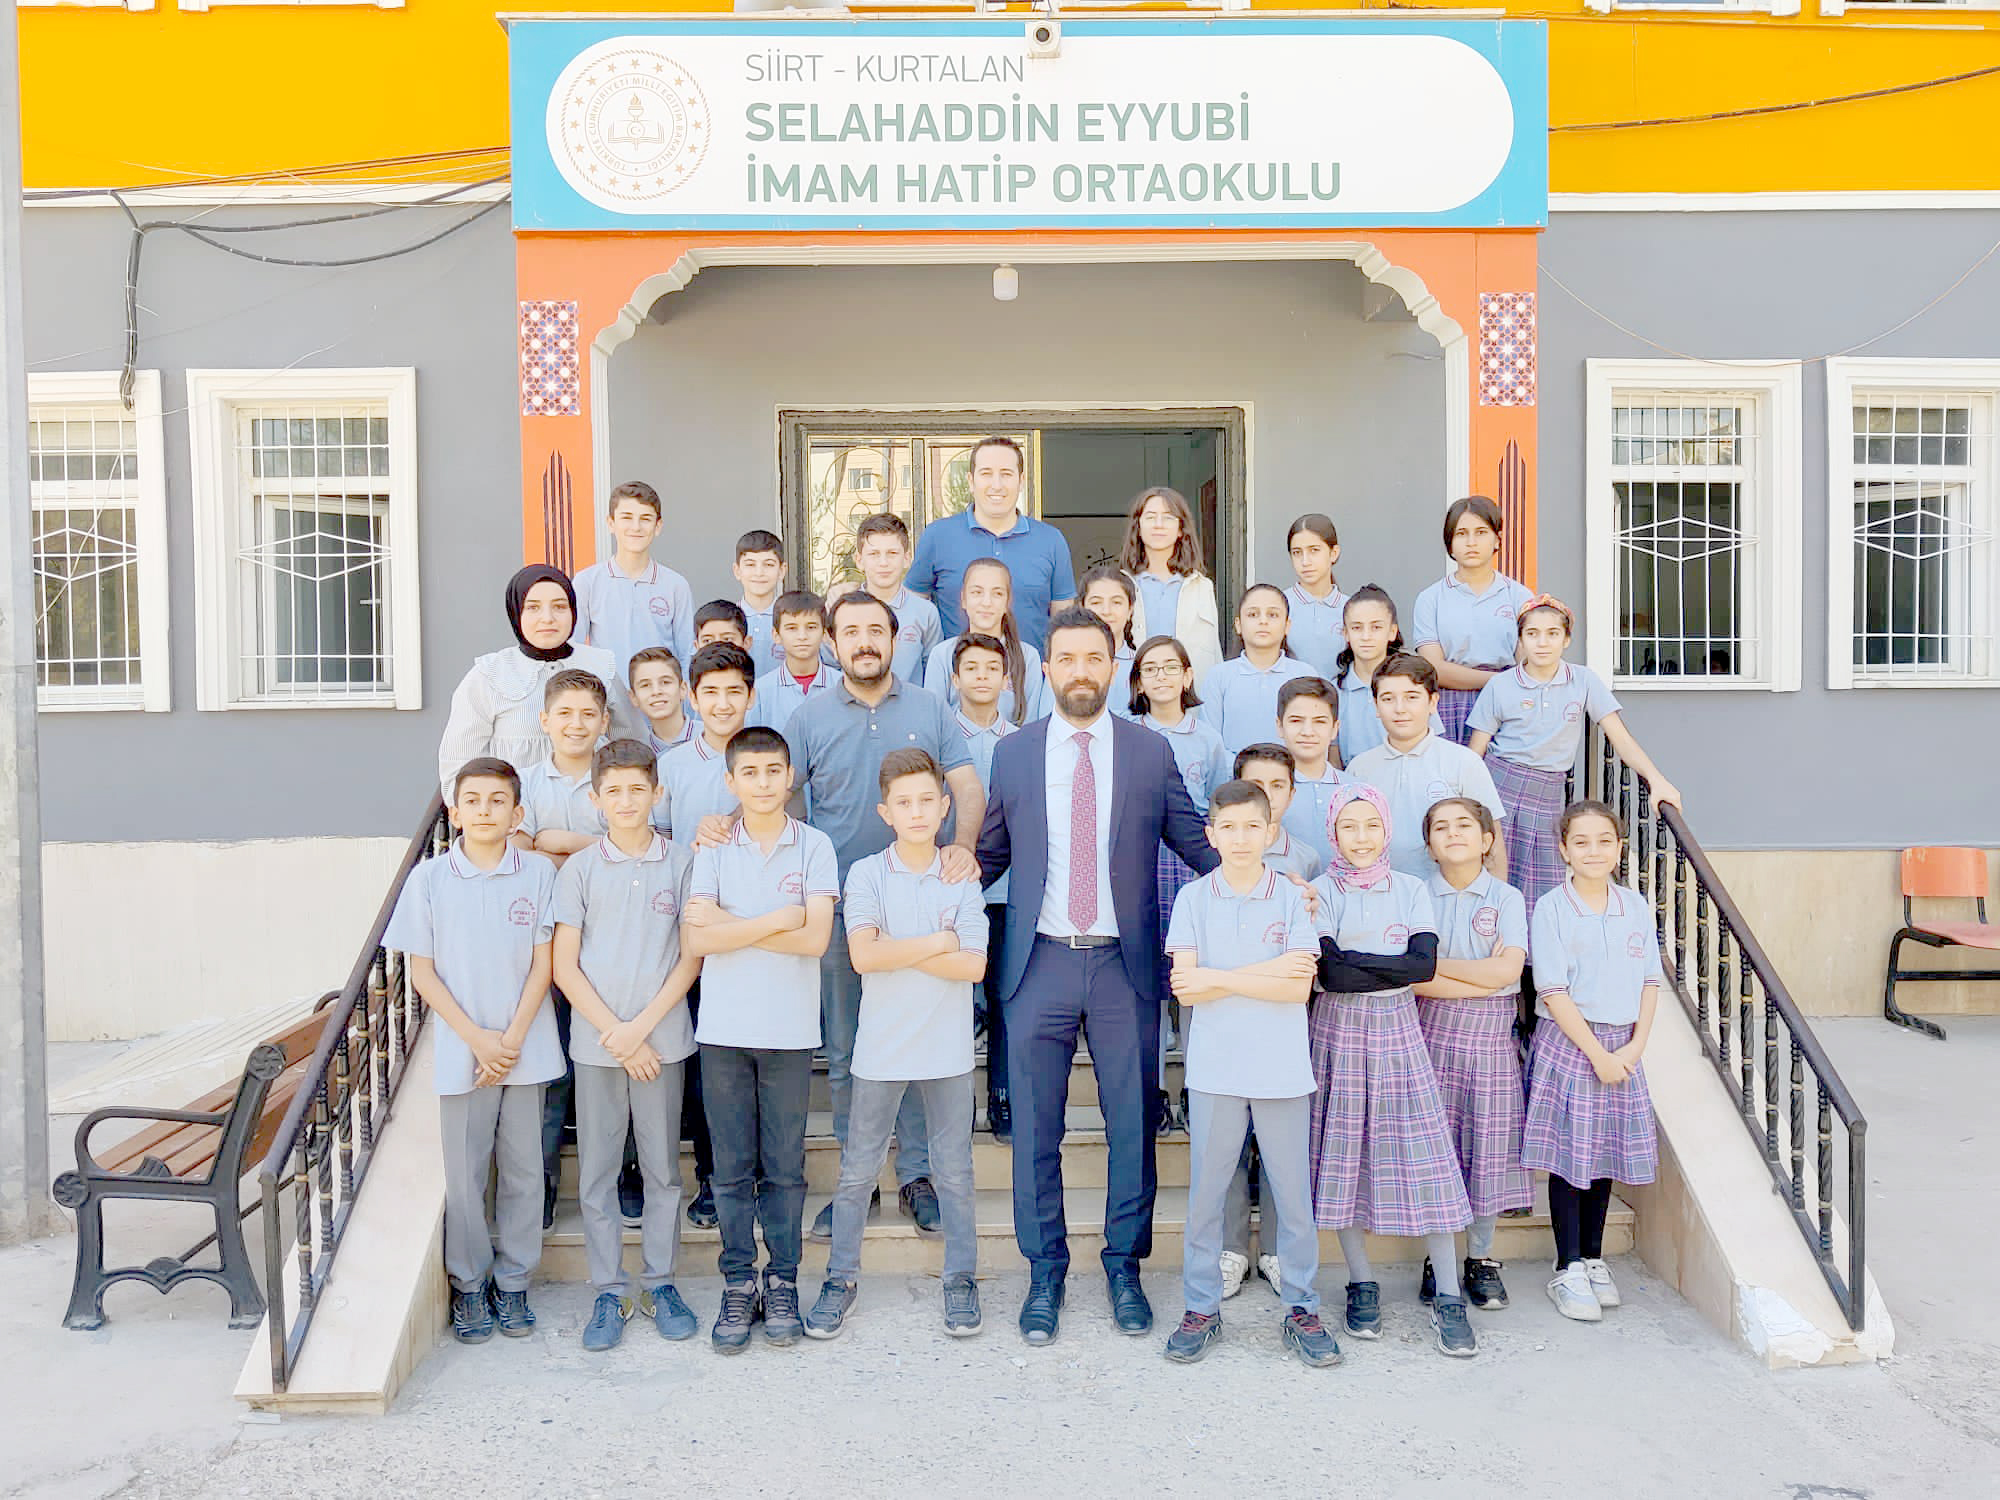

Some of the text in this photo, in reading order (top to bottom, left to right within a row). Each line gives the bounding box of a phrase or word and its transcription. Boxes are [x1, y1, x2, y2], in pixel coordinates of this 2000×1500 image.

[746, 48, 822, 82] SİİRT
[856, 54, 1024, 82] KURTALAN
[745, 91, 1248, 142] SELAHADDİN EYYUBİ
[747, 153, 1341, 202] İMAM HATİP ORTAOKULU
